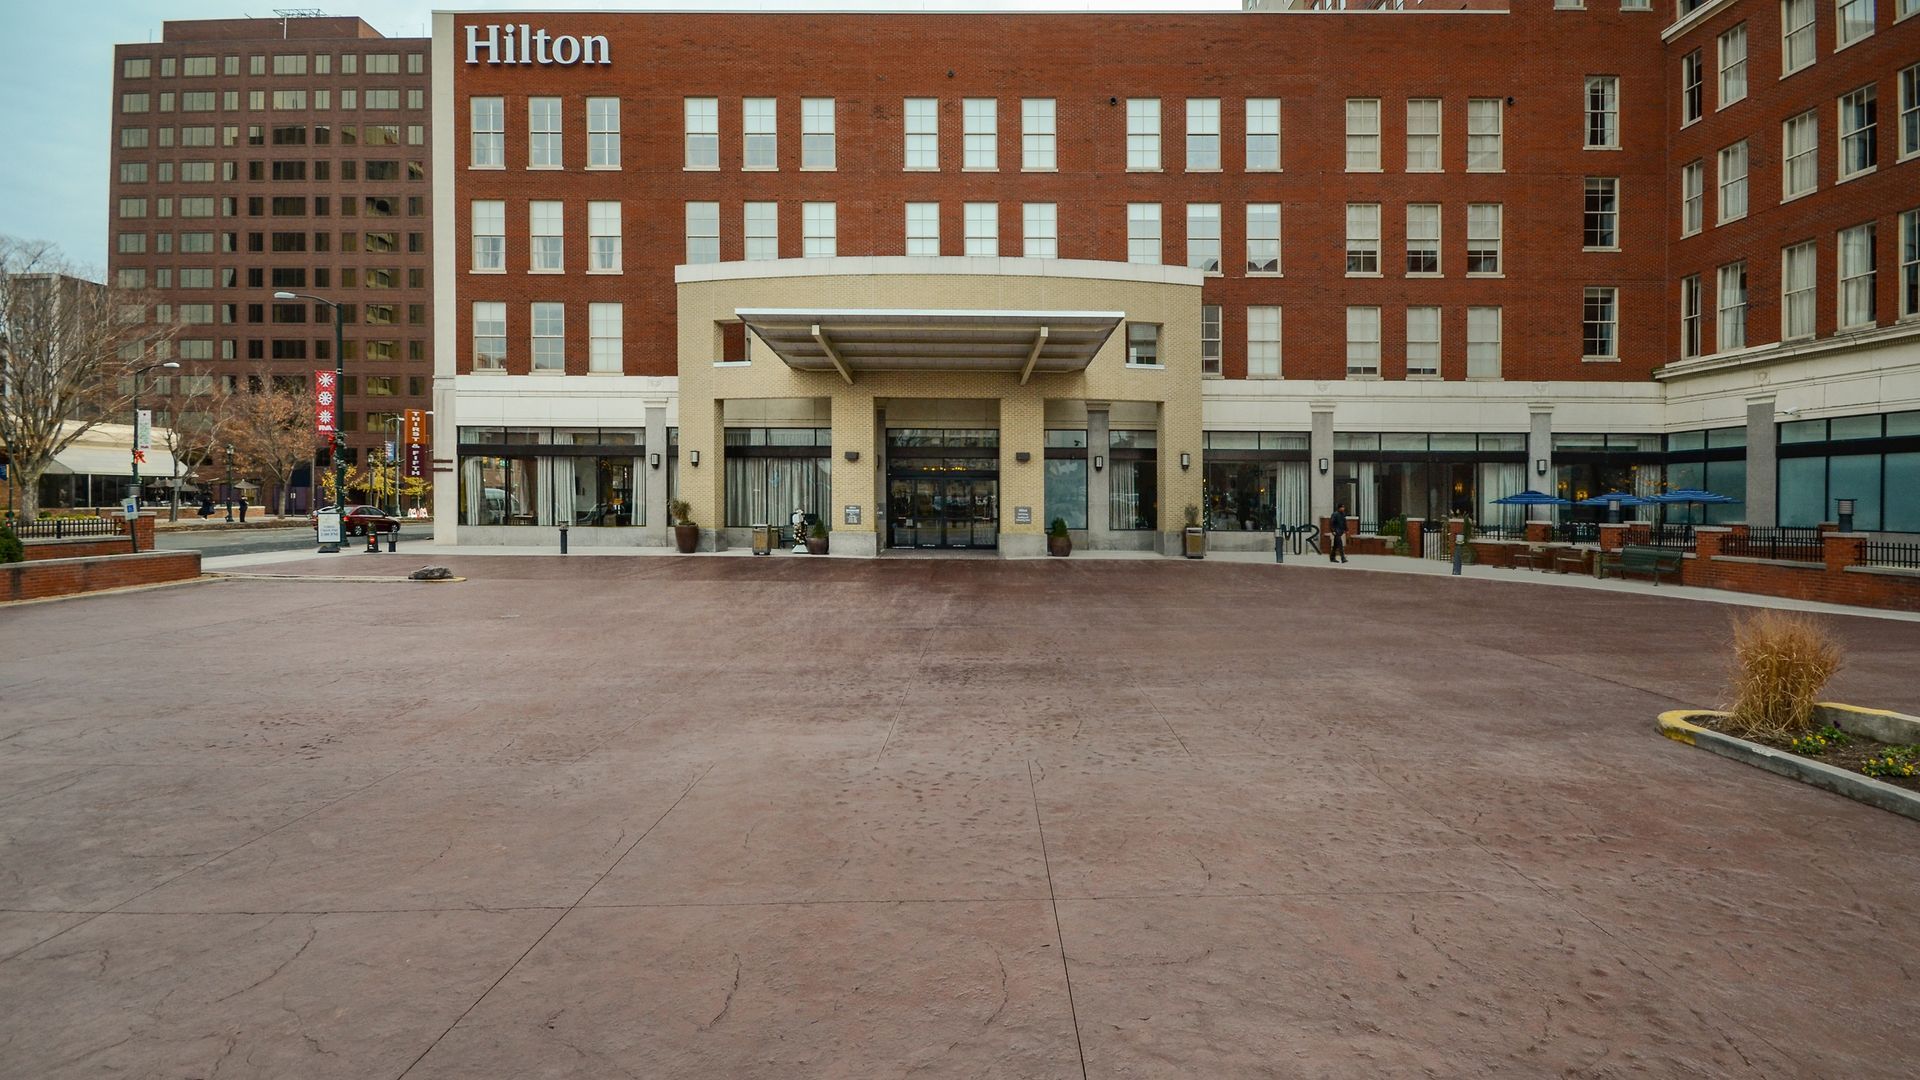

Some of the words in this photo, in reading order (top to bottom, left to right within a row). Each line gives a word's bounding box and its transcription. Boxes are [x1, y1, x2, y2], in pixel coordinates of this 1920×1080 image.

[464, 23, 611, 64] Hilton
[411, 411, 420, 441] THIRST
[411, 450, 420, 476] FIFTH
